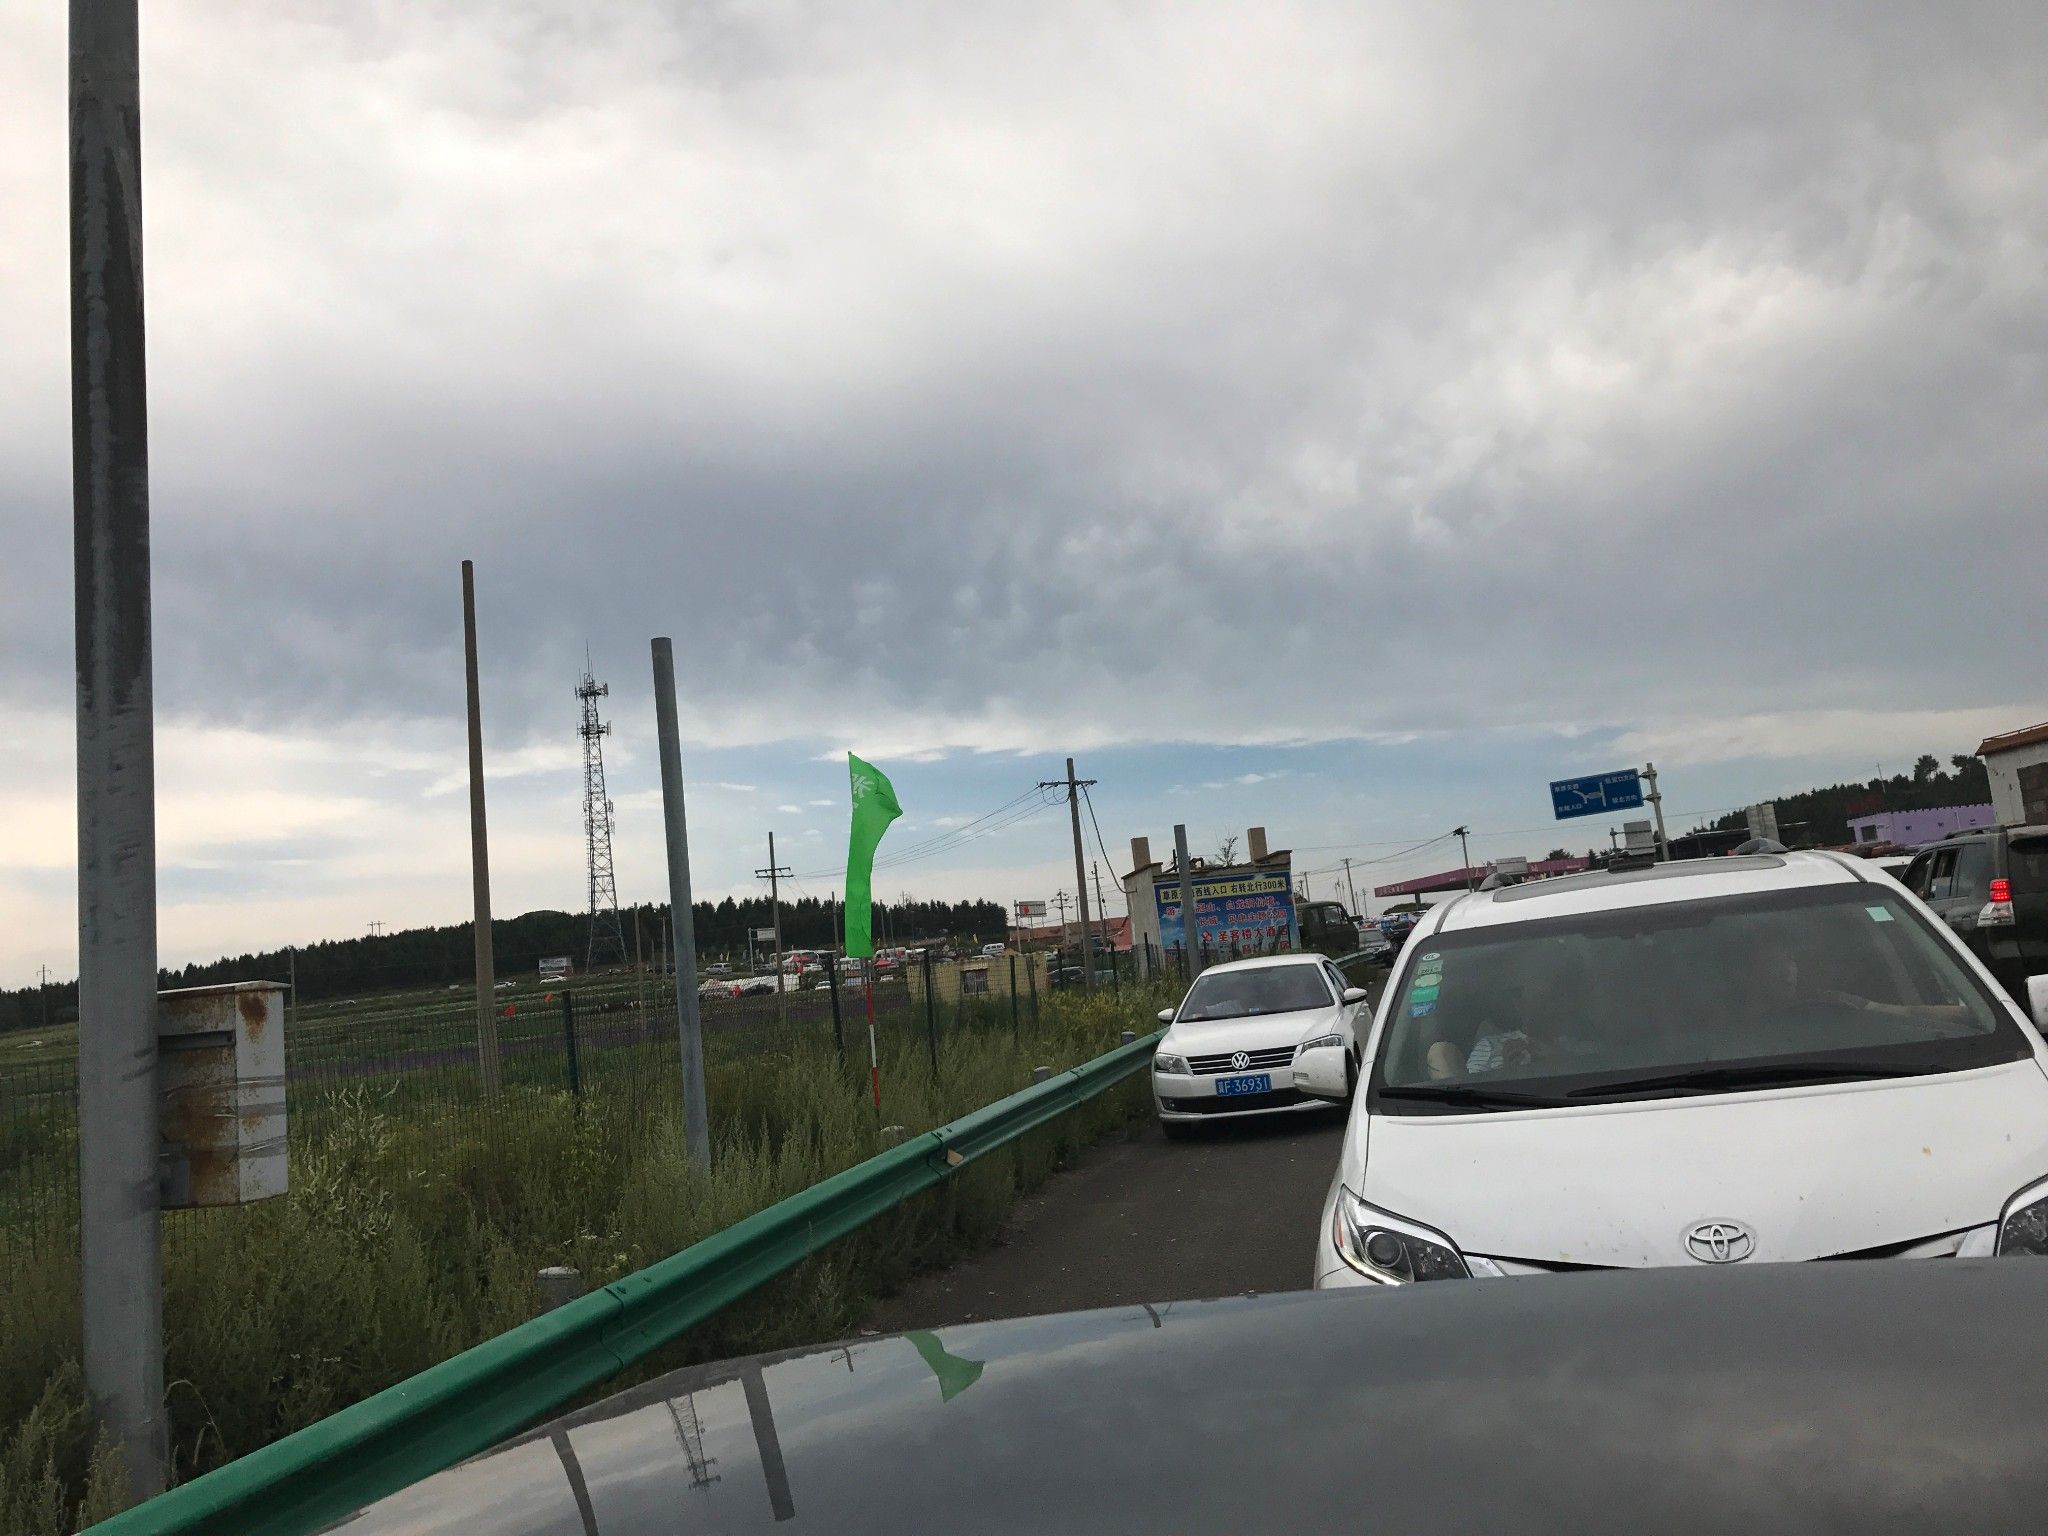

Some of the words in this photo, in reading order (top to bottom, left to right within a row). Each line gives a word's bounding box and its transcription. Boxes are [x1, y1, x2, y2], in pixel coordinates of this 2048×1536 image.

[1162, 885, 1227, 901] 草原天西线入口
[1230, 880, 1286, 894] 右转北行300米
